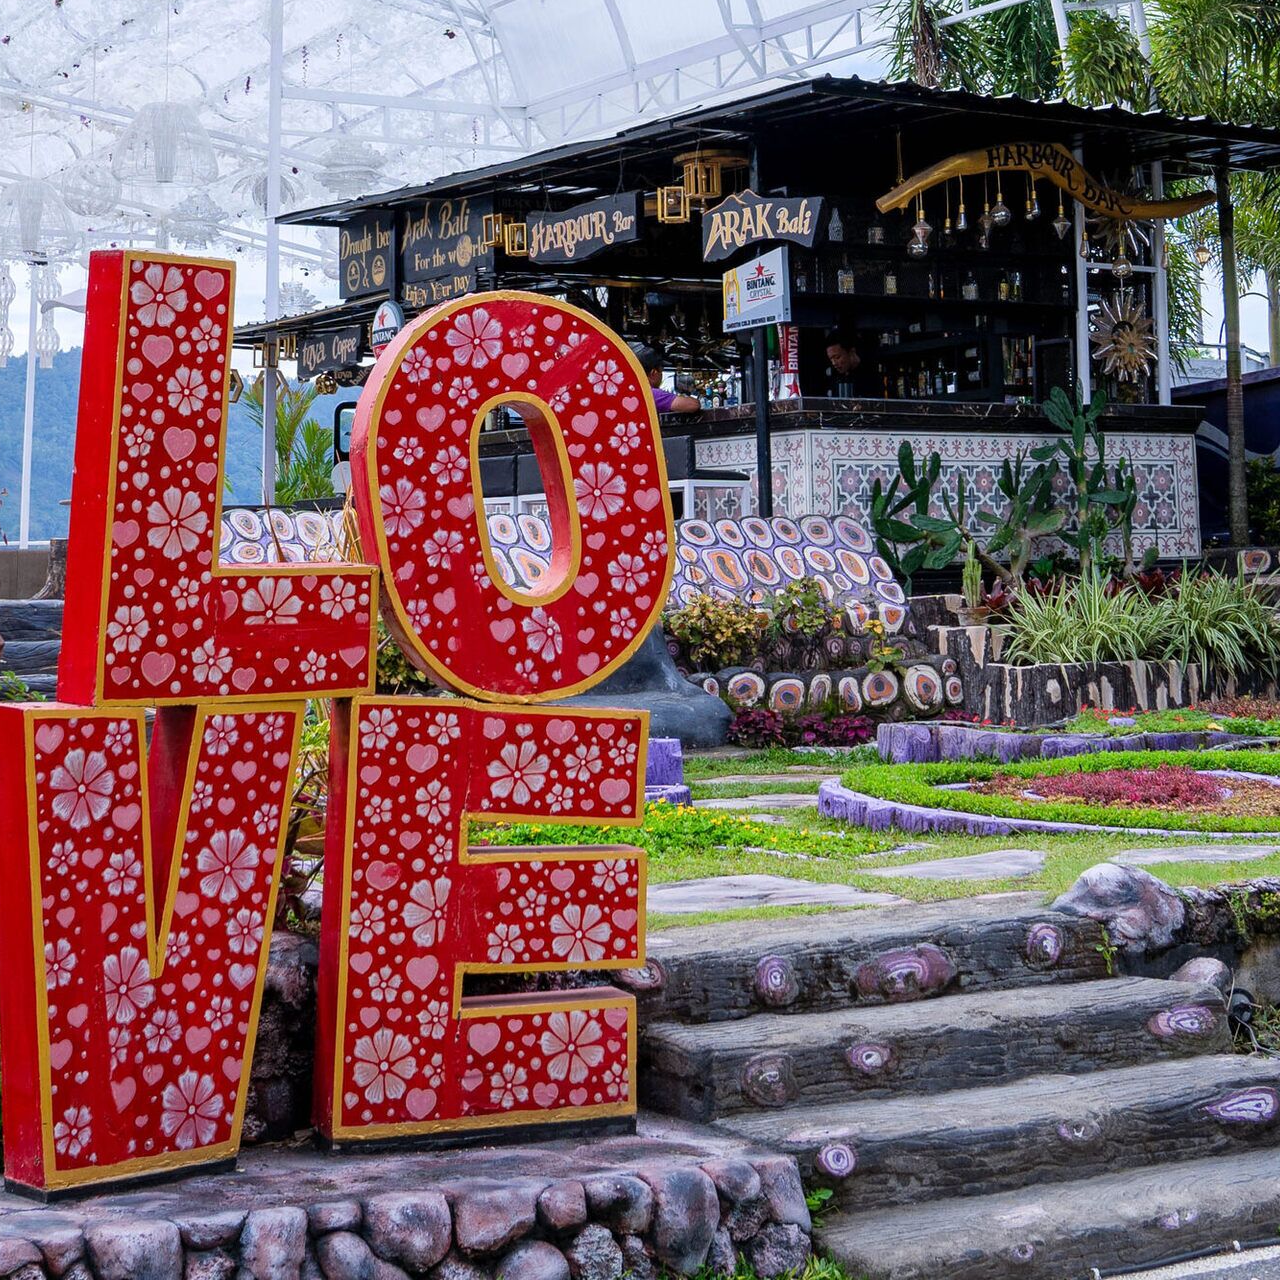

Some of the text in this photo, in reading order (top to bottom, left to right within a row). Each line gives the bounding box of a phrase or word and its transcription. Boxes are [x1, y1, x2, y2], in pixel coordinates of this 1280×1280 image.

[986, 143, 1132, 215] HARBOUR BAR
[400, 199, 470, 256] Arak Bali
[530, 210, 635, 258] HARBOUR Bar
[703, 199, 812, 259] ARAK Bali
[415, 253, 431, 271] For
[433, 248, 446, 268] the
[746, 276, 775, 291] BINTANG
[332, 335, 357, 364] Coffee
